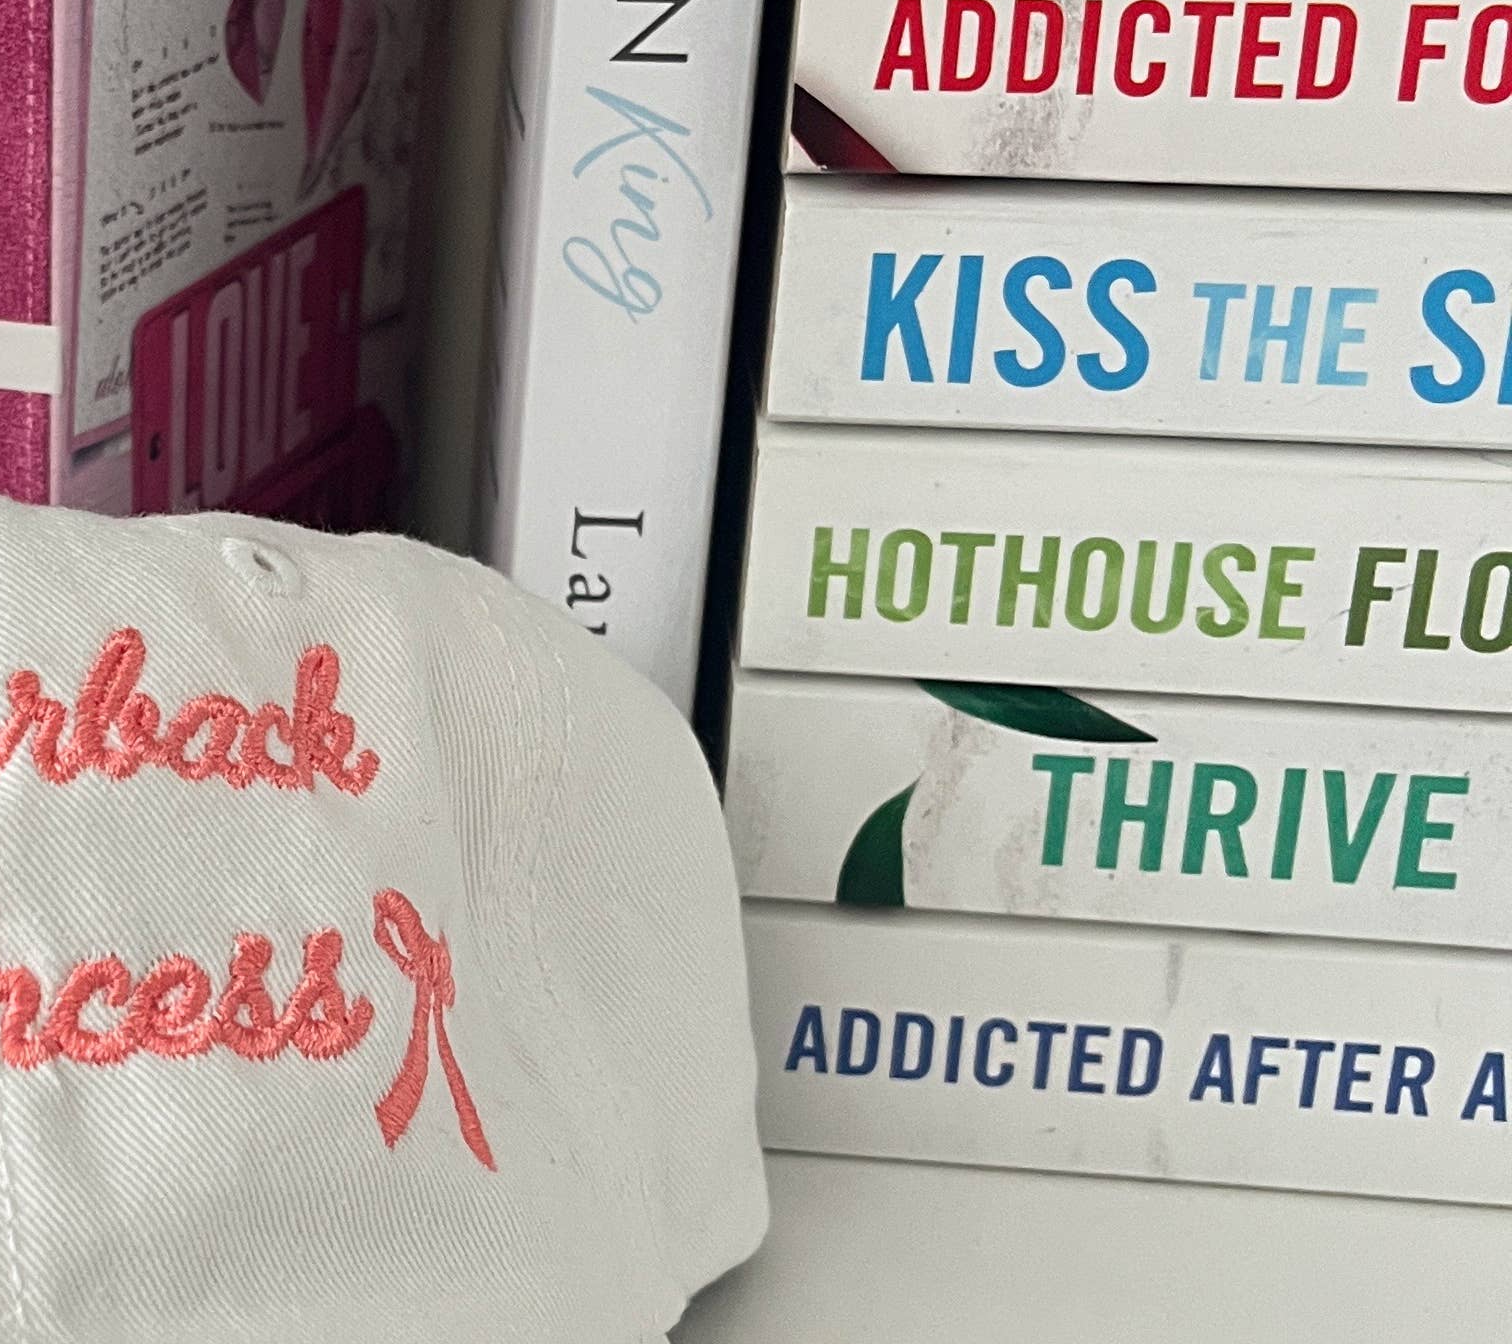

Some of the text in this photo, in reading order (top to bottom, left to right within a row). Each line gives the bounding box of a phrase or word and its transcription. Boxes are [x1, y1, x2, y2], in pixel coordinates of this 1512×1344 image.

[1397, 3, 1512, 105] FO
[563, 85, 713, 324] King
[860, 251, 1512, 405] KISS THE S
[806, 526, 1512, 653] HOTHOUSE FLO
[1032, 754, 1470, 891] THRIVE
[784, 1005, 1507, 1122] ADDICTED AFTER A
